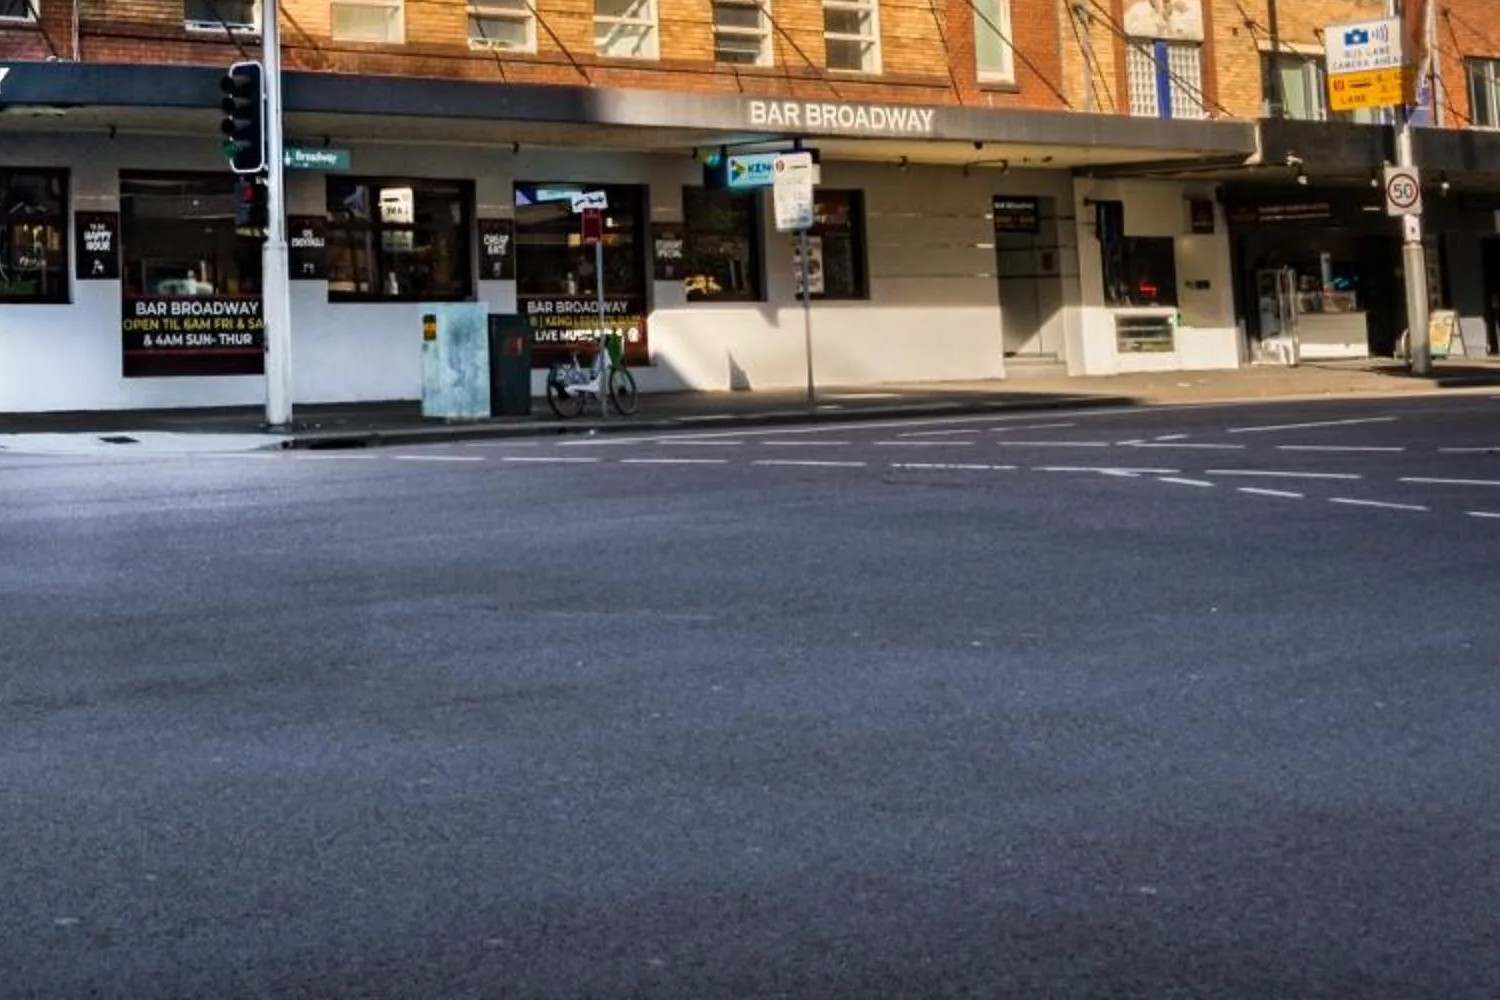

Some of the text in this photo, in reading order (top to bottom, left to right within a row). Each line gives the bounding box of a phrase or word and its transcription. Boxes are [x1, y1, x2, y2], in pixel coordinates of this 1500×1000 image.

[1333, 58, 1369, 69] CAMERA
[750, 100, 934, 132] BAR BROADWAY
[296, 149, 337, 164] Broadway
[748, 159, 773, 174] KEN
[1393, 183, 1413, 199] 50
[135, 301, 259, 315] BAR BROADWAY
[527, 301, 553, 313] BAR
[124, 319, 159, 331] OPEN
[163, 318, 179, 330] TIL
[215, 318, 233, 329] FRI
[247, 318, 264, 329] SA
[143, 334, 152, 346] &
[155, 334, 183, 346] 4AM
[219, 333, 252, 345] THUR
[535, 330, 558, 341] LIVE
